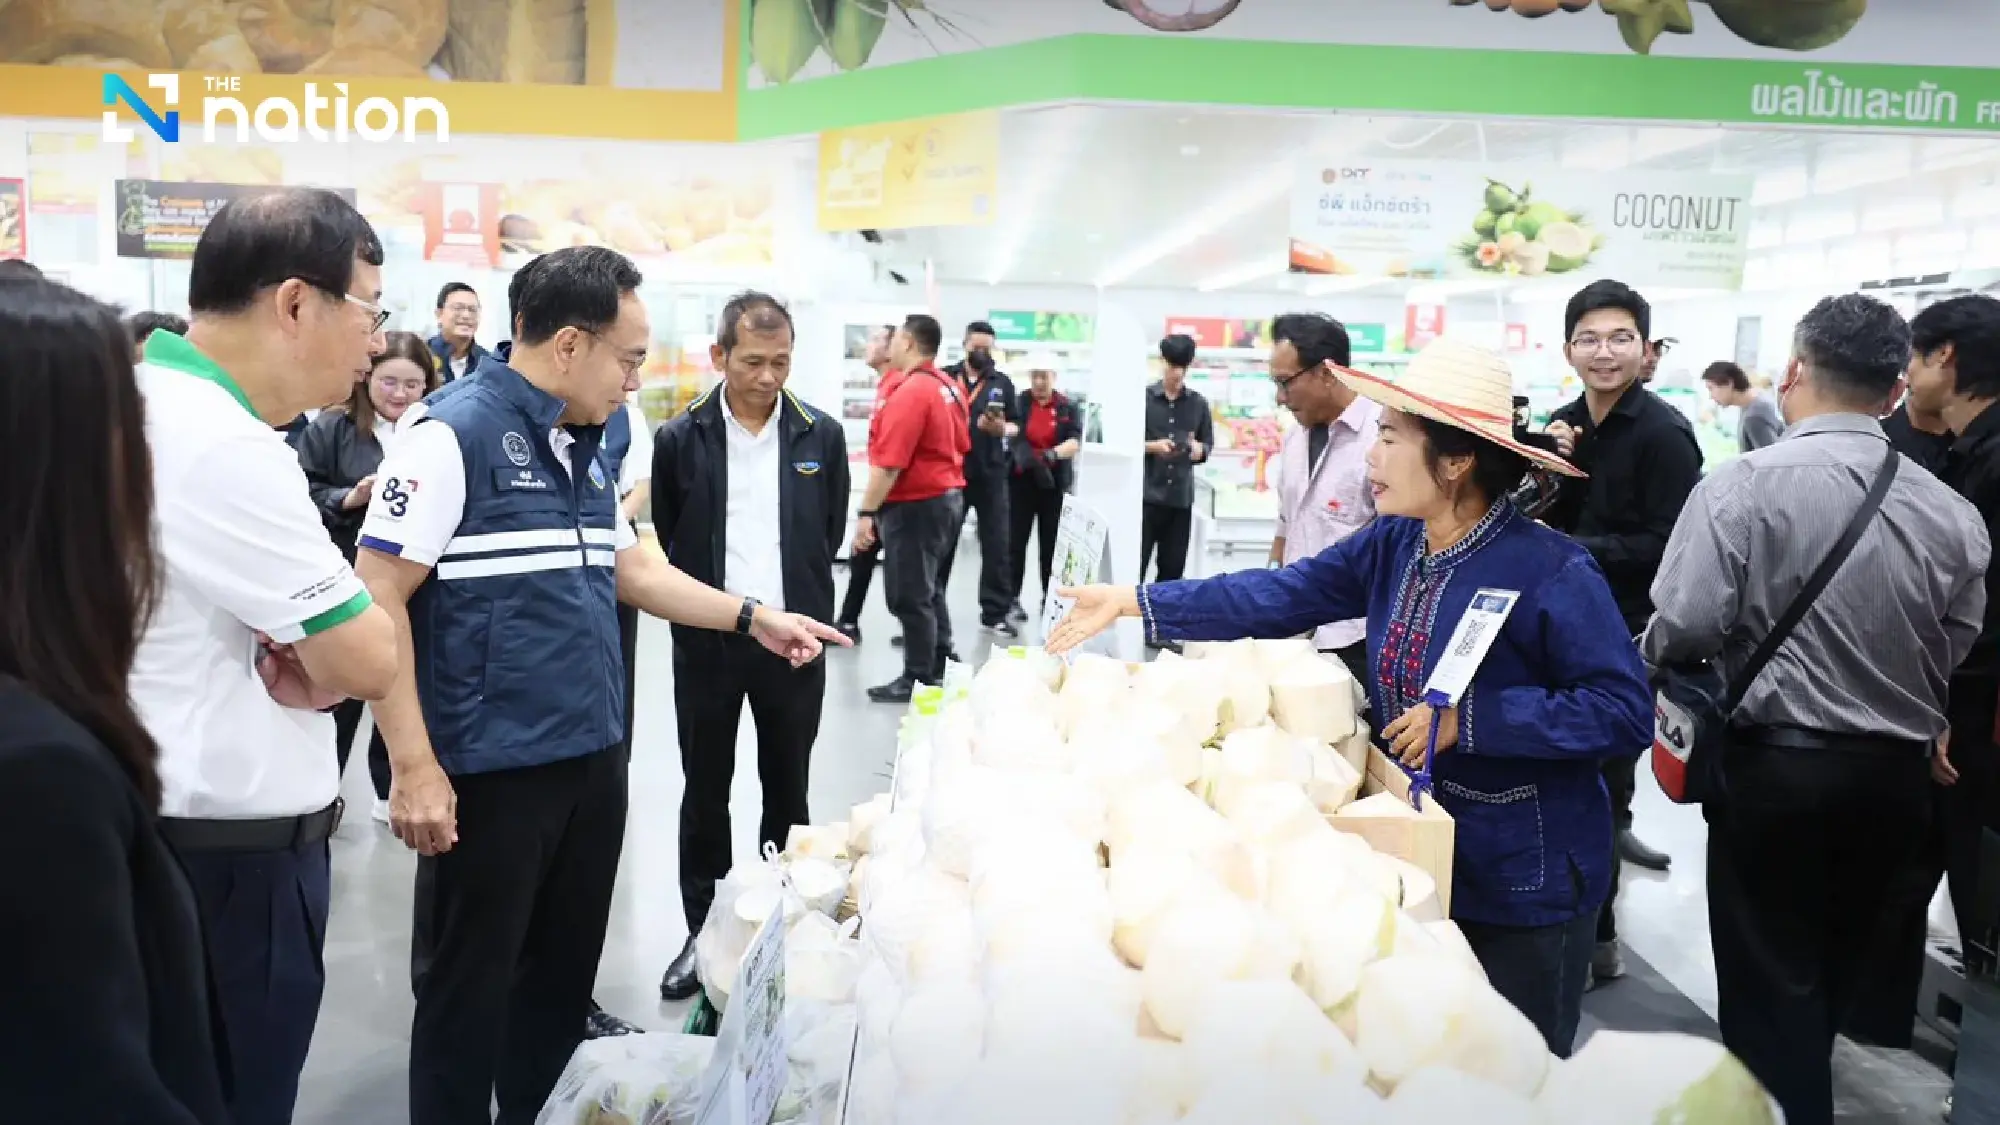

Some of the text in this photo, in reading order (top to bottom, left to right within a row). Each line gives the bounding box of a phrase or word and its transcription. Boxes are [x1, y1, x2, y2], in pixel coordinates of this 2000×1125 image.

[1751, 69, 1958, 123] ผลไม้และผัก
[1613, 193, 1742, 232] COCONUT
